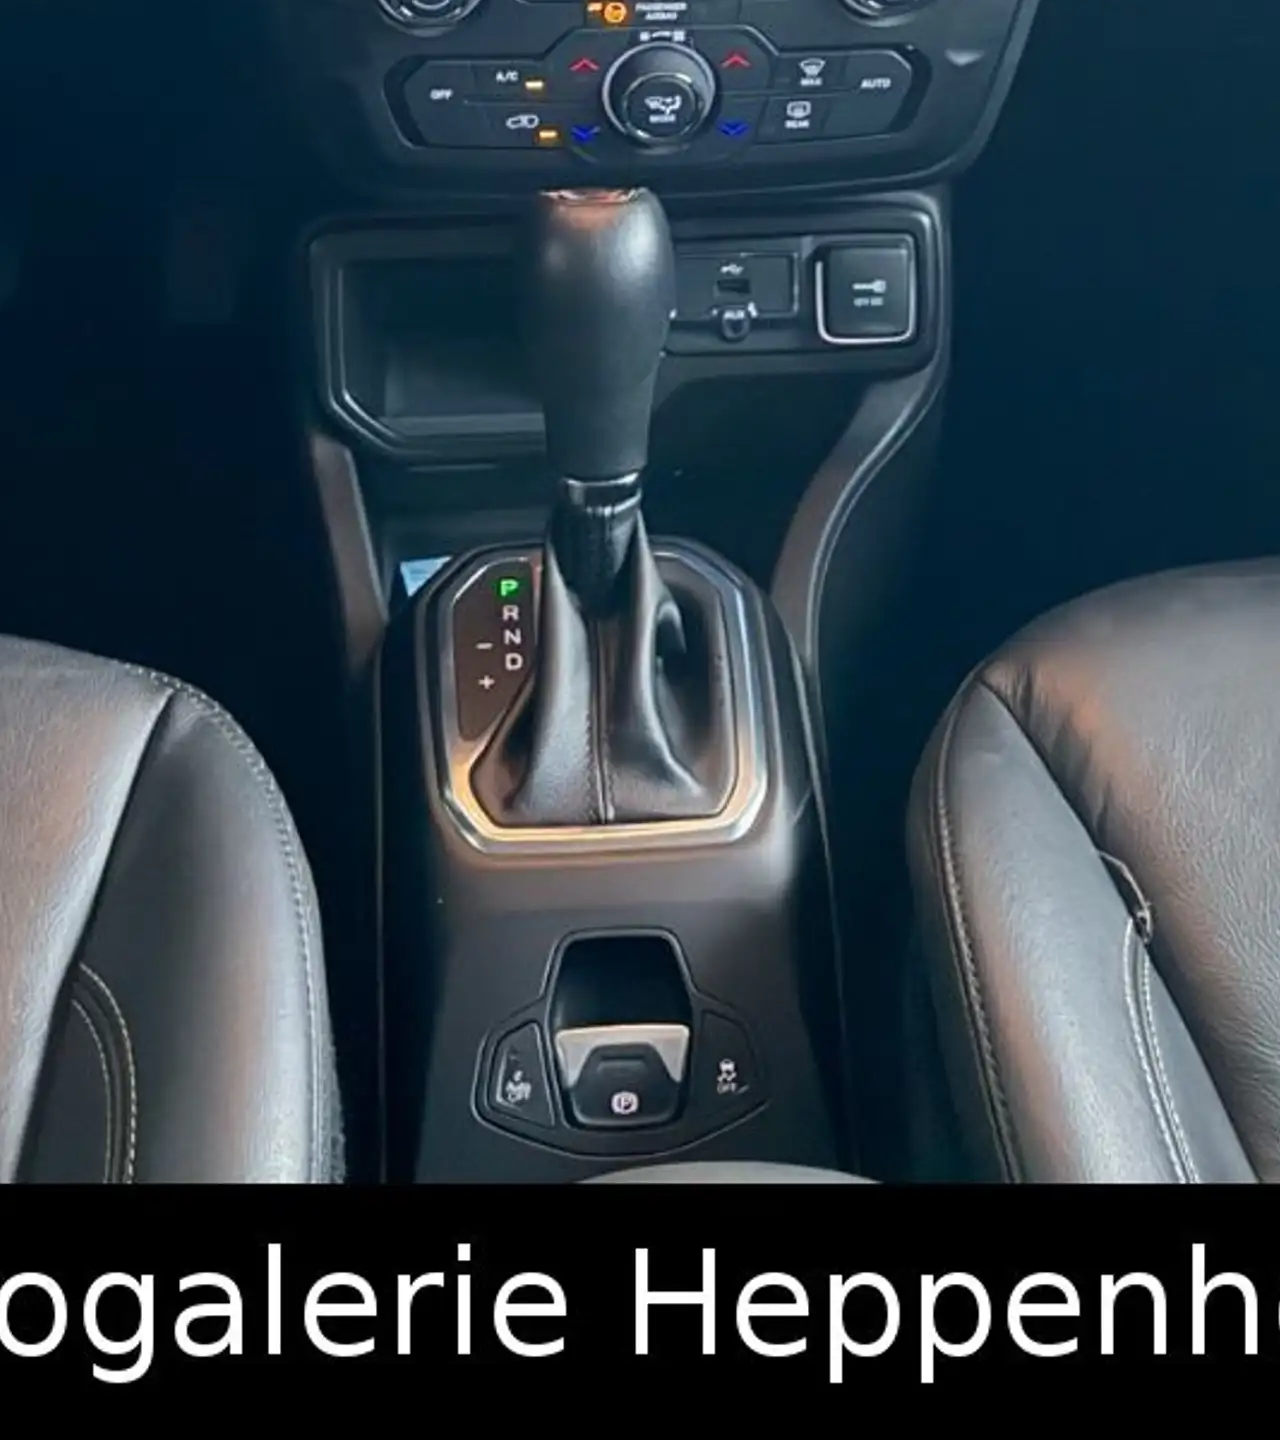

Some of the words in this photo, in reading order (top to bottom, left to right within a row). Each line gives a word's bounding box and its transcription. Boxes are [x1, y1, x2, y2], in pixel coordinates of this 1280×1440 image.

[860, 77, 893, 90] AUTO
[429, 88, 453, 101] OFF
[499, 578, 520, 597] P
[502, 605, 520, 621] R
[504, 628, 522, 645] N
[505, 653, 523, 671] D
